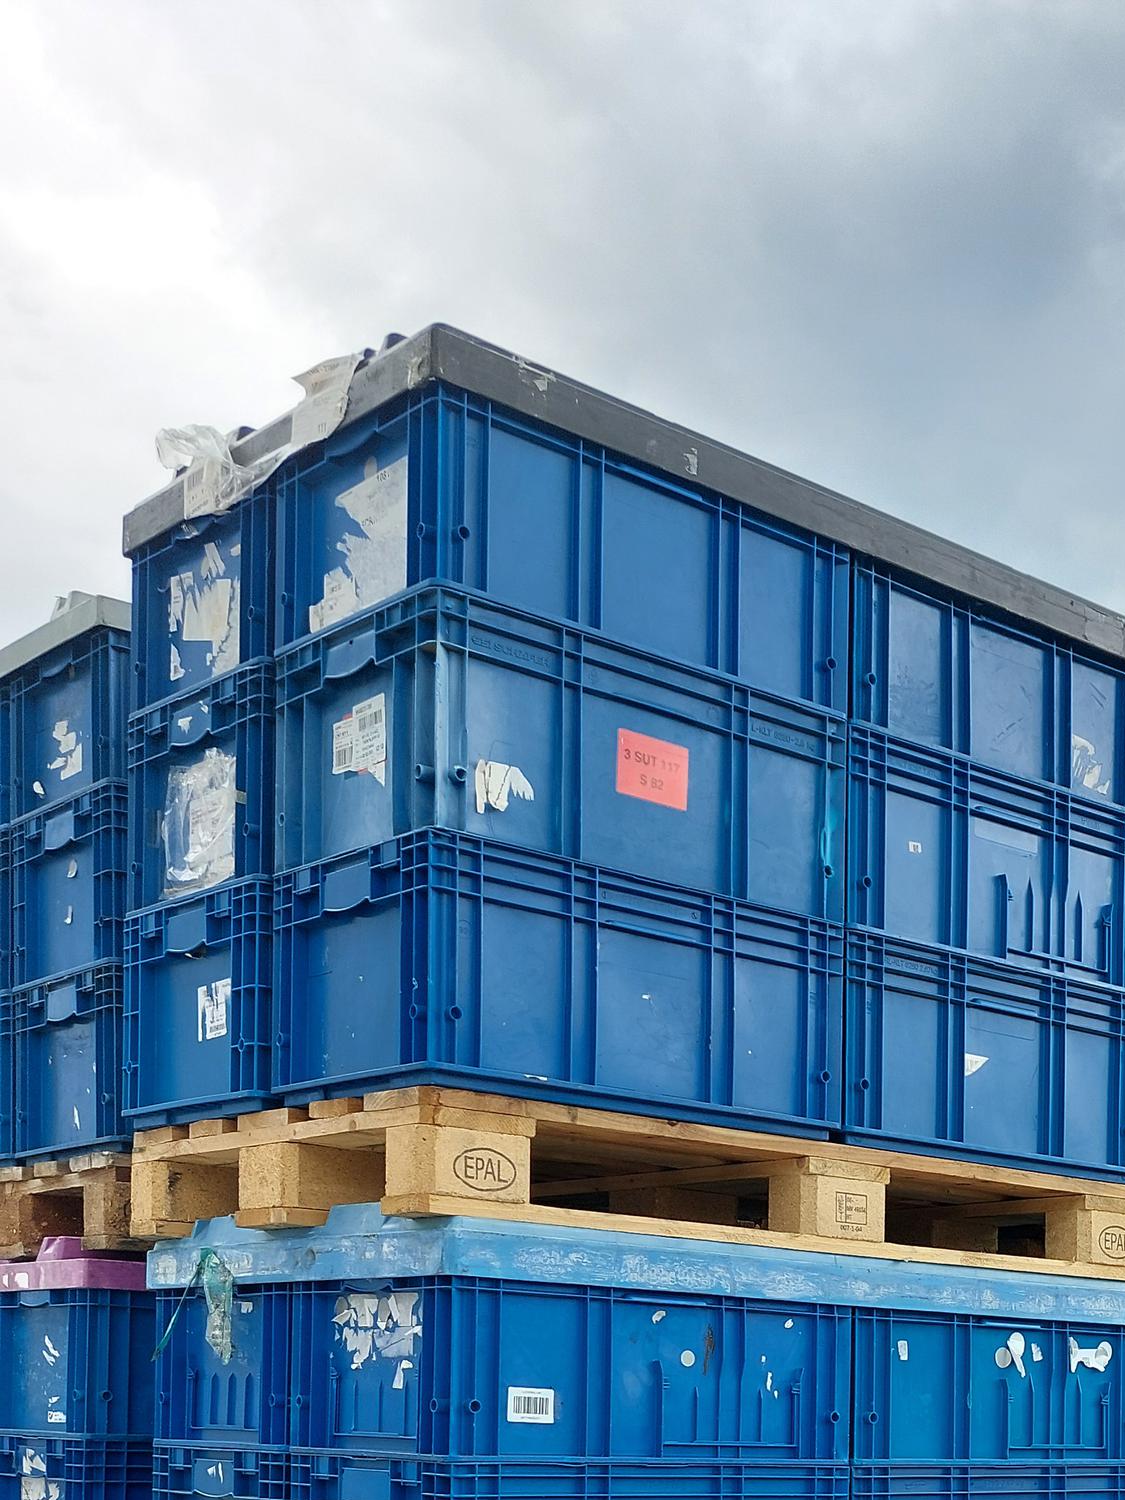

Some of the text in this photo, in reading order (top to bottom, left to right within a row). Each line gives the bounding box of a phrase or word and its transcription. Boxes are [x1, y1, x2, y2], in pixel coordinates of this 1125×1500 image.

[624, 748, 631, 760] 3
[634, 751, 656, 767] SUT
[640, 774, 647, 786] S
[464, 1155, 508, 1183] EPAL
